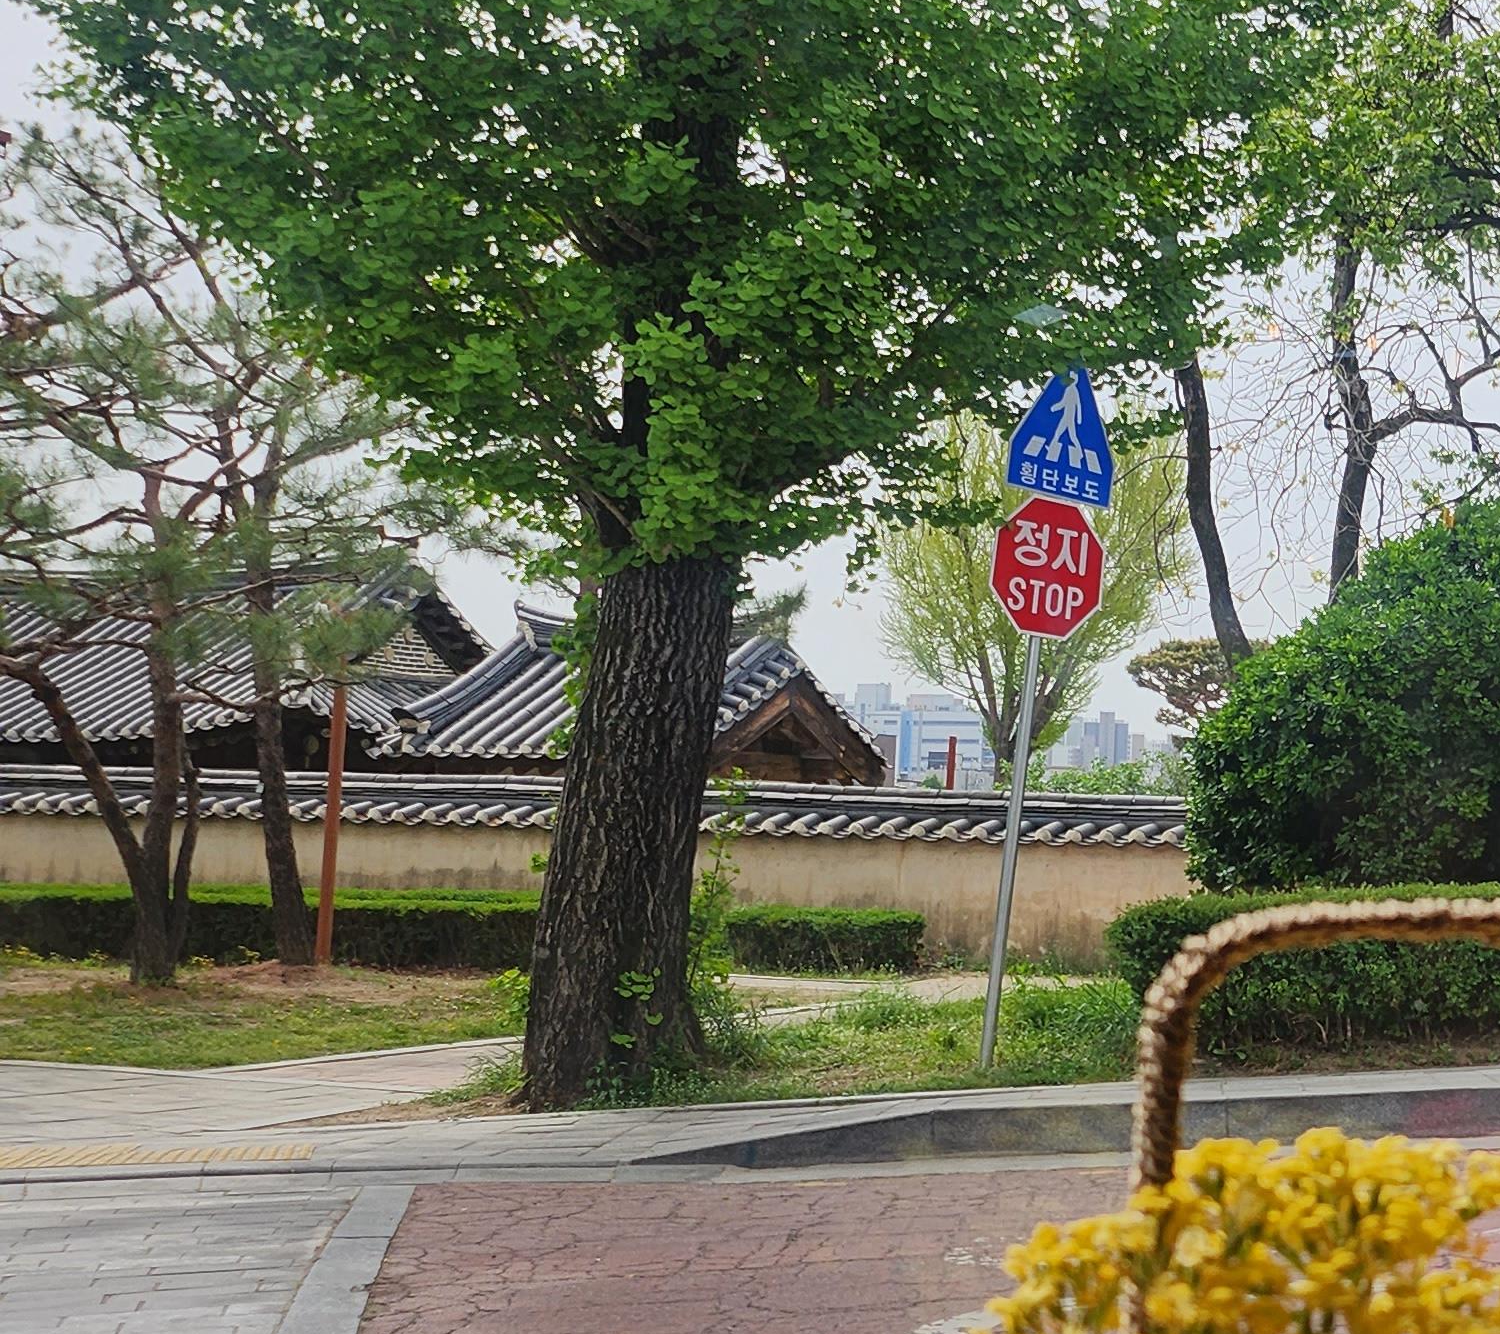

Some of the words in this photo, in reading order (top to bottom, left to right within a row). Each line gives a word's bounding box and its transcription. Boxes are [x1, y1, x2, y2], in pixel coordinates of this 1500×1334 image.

[1019, 460, 1100, 501] 횡단보도
[1013, 519, 1090, 577] 정지
[1006, 576, 1085, 620] STOP
